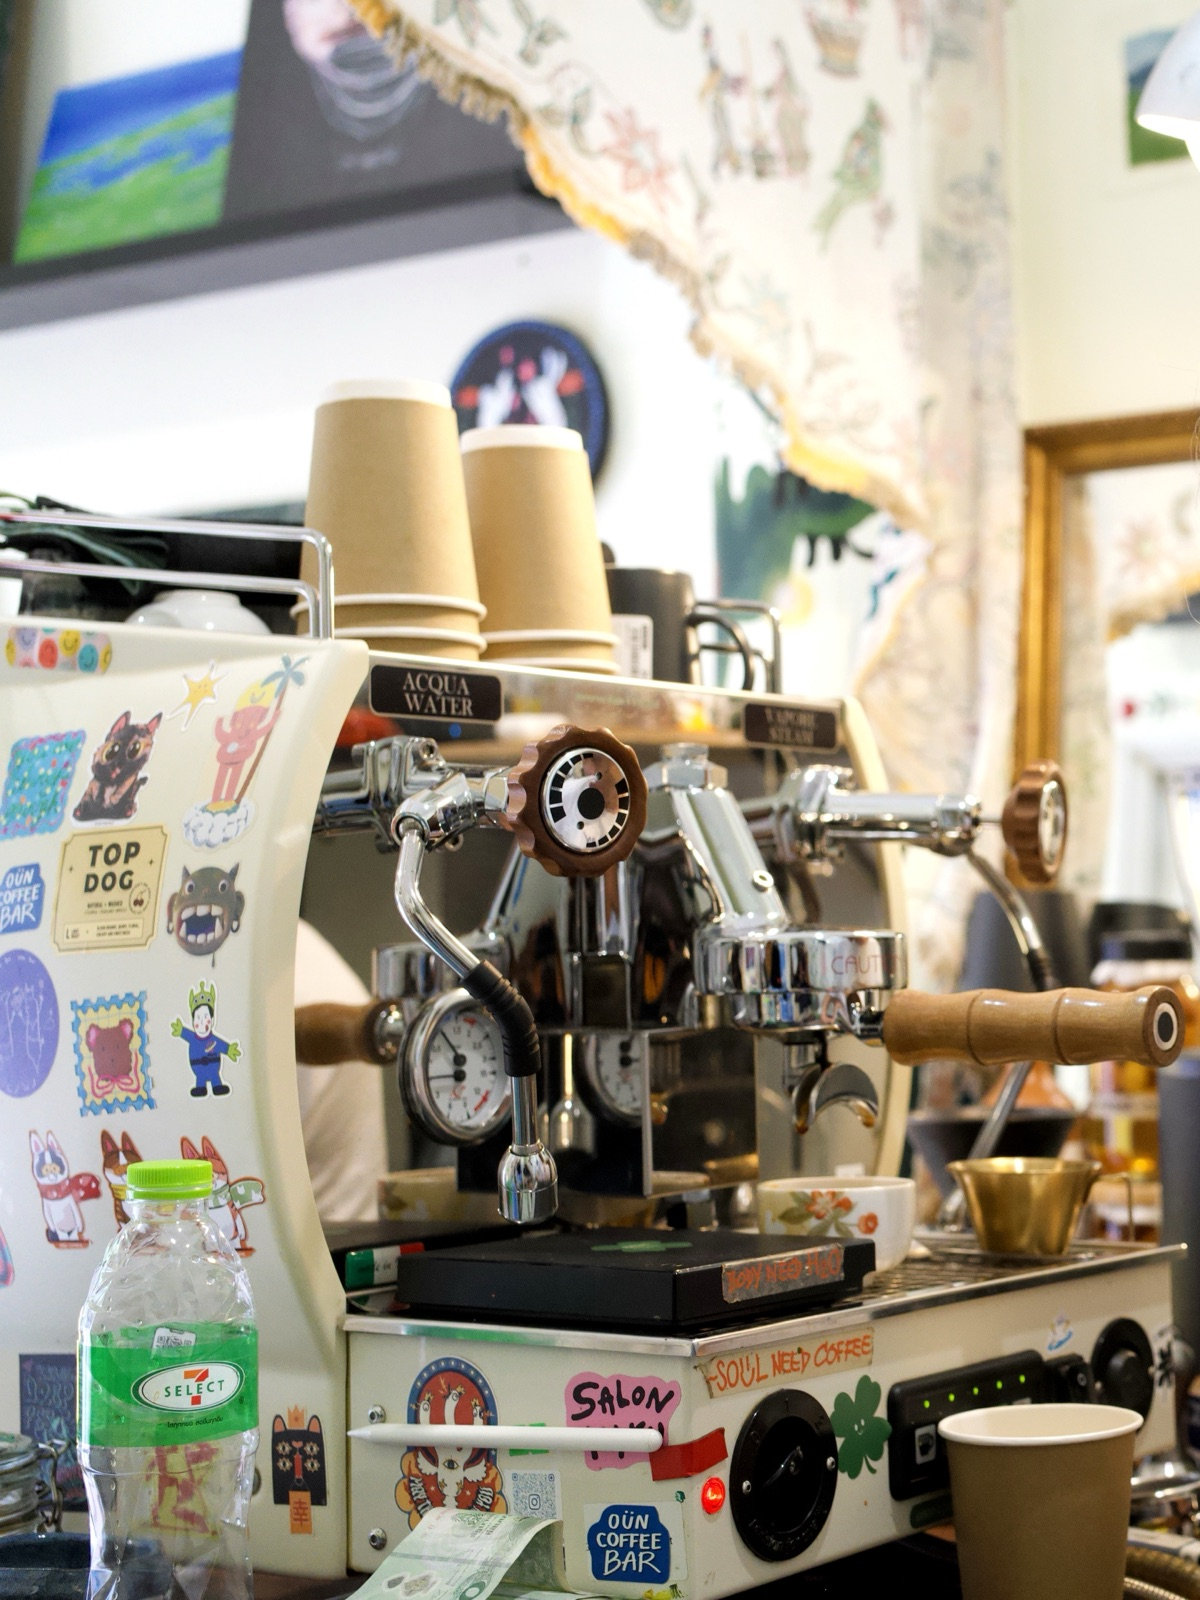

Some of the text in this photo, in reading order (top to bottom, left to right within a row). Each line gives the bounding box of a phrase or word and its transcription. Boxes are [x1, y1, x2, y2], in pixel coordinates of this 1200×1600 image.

[402, 671, 471, 696] ACQUA
[404, 692, 475, 717] WATER
[88, 841, 141, 868] TOP
[83, 869, 134, 894] DOG
[0, 902, 37, 930] BAR
[771, 1349, 811, 1377] NEED
[813, 1333, 873, 1368] COFFEE
[164, 1379, 225, 1398] SELECT
[571, 1379, 675, 1421] SALON
[607, 1509, 650, 1530] OÜN
[595, 1531, 663, 1551] COFFEE
[602, 1549, 662, 1576] BAR
